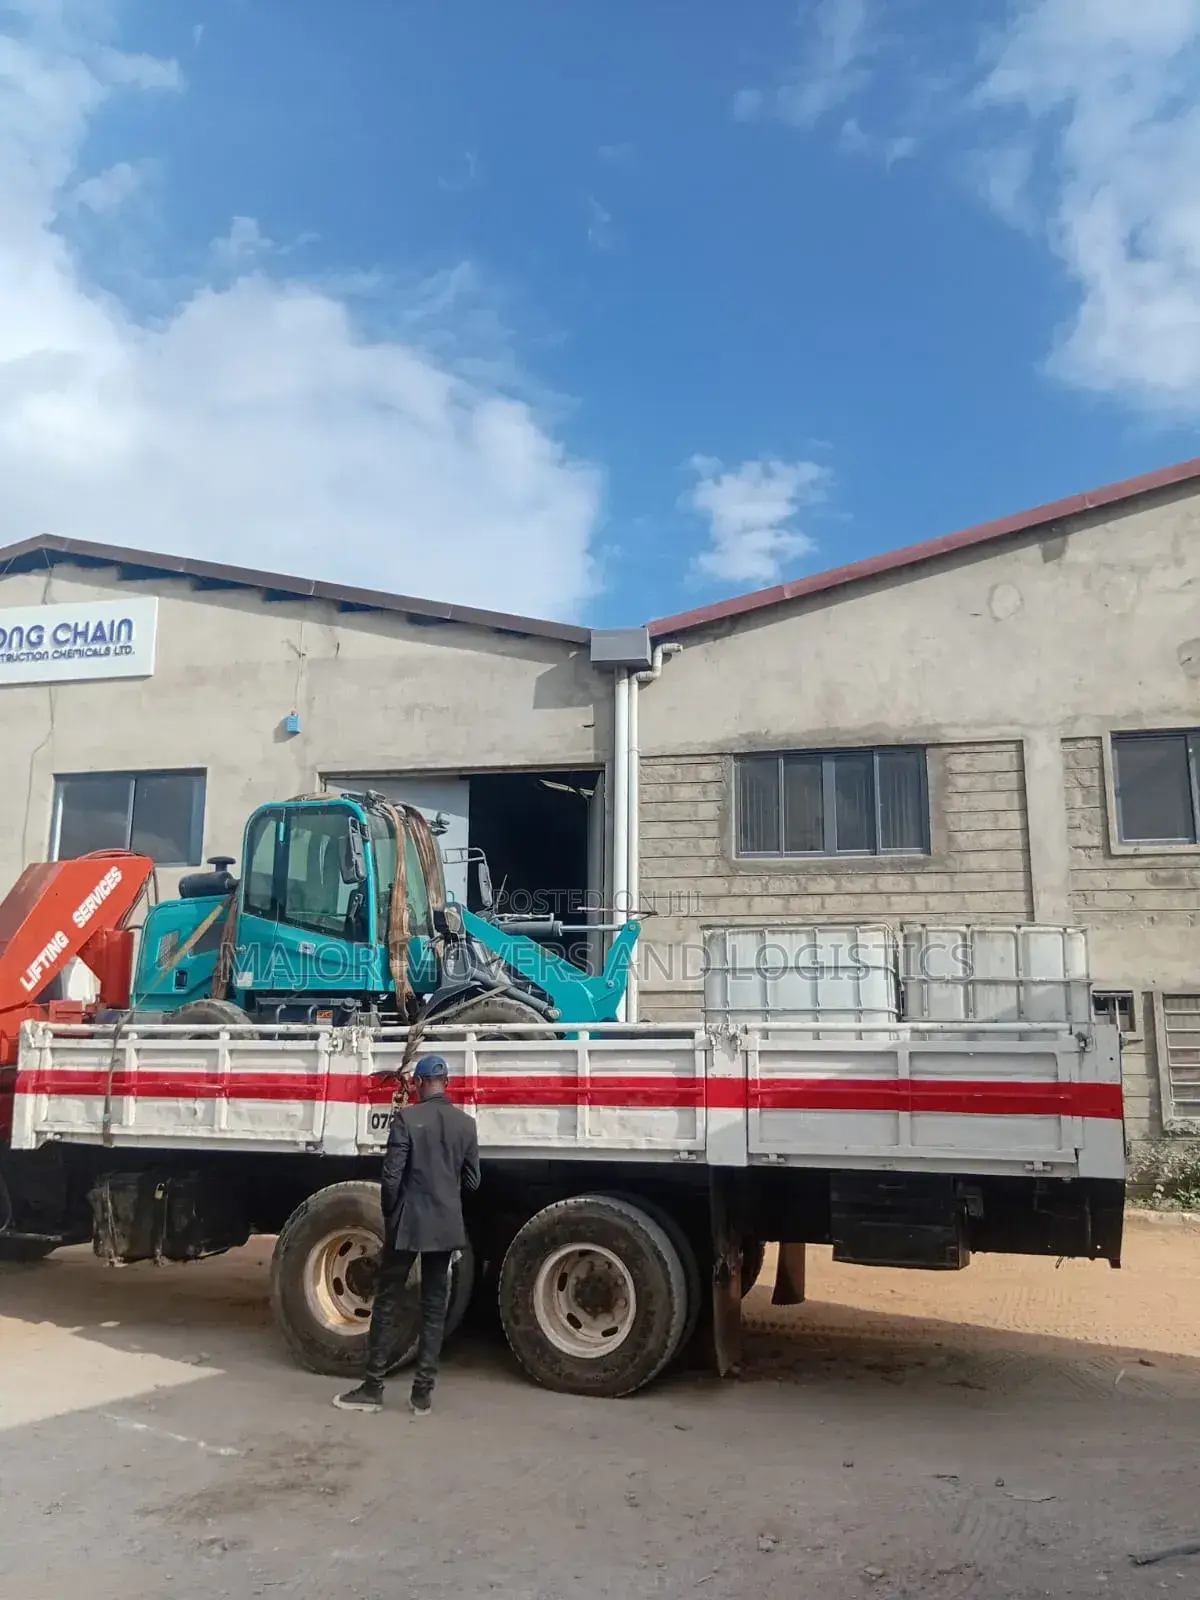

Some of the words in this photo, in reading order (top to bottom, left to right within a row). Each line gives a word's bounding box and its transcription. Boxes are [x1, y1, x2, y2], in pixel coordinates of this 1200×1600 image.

[52, 618, 134, 645] CHAIN
[52, 646, 111, 660] CHEMICALS
[19, 930, 70, 992] LIFTING
[72, 865, 123, 929] SERVICES
